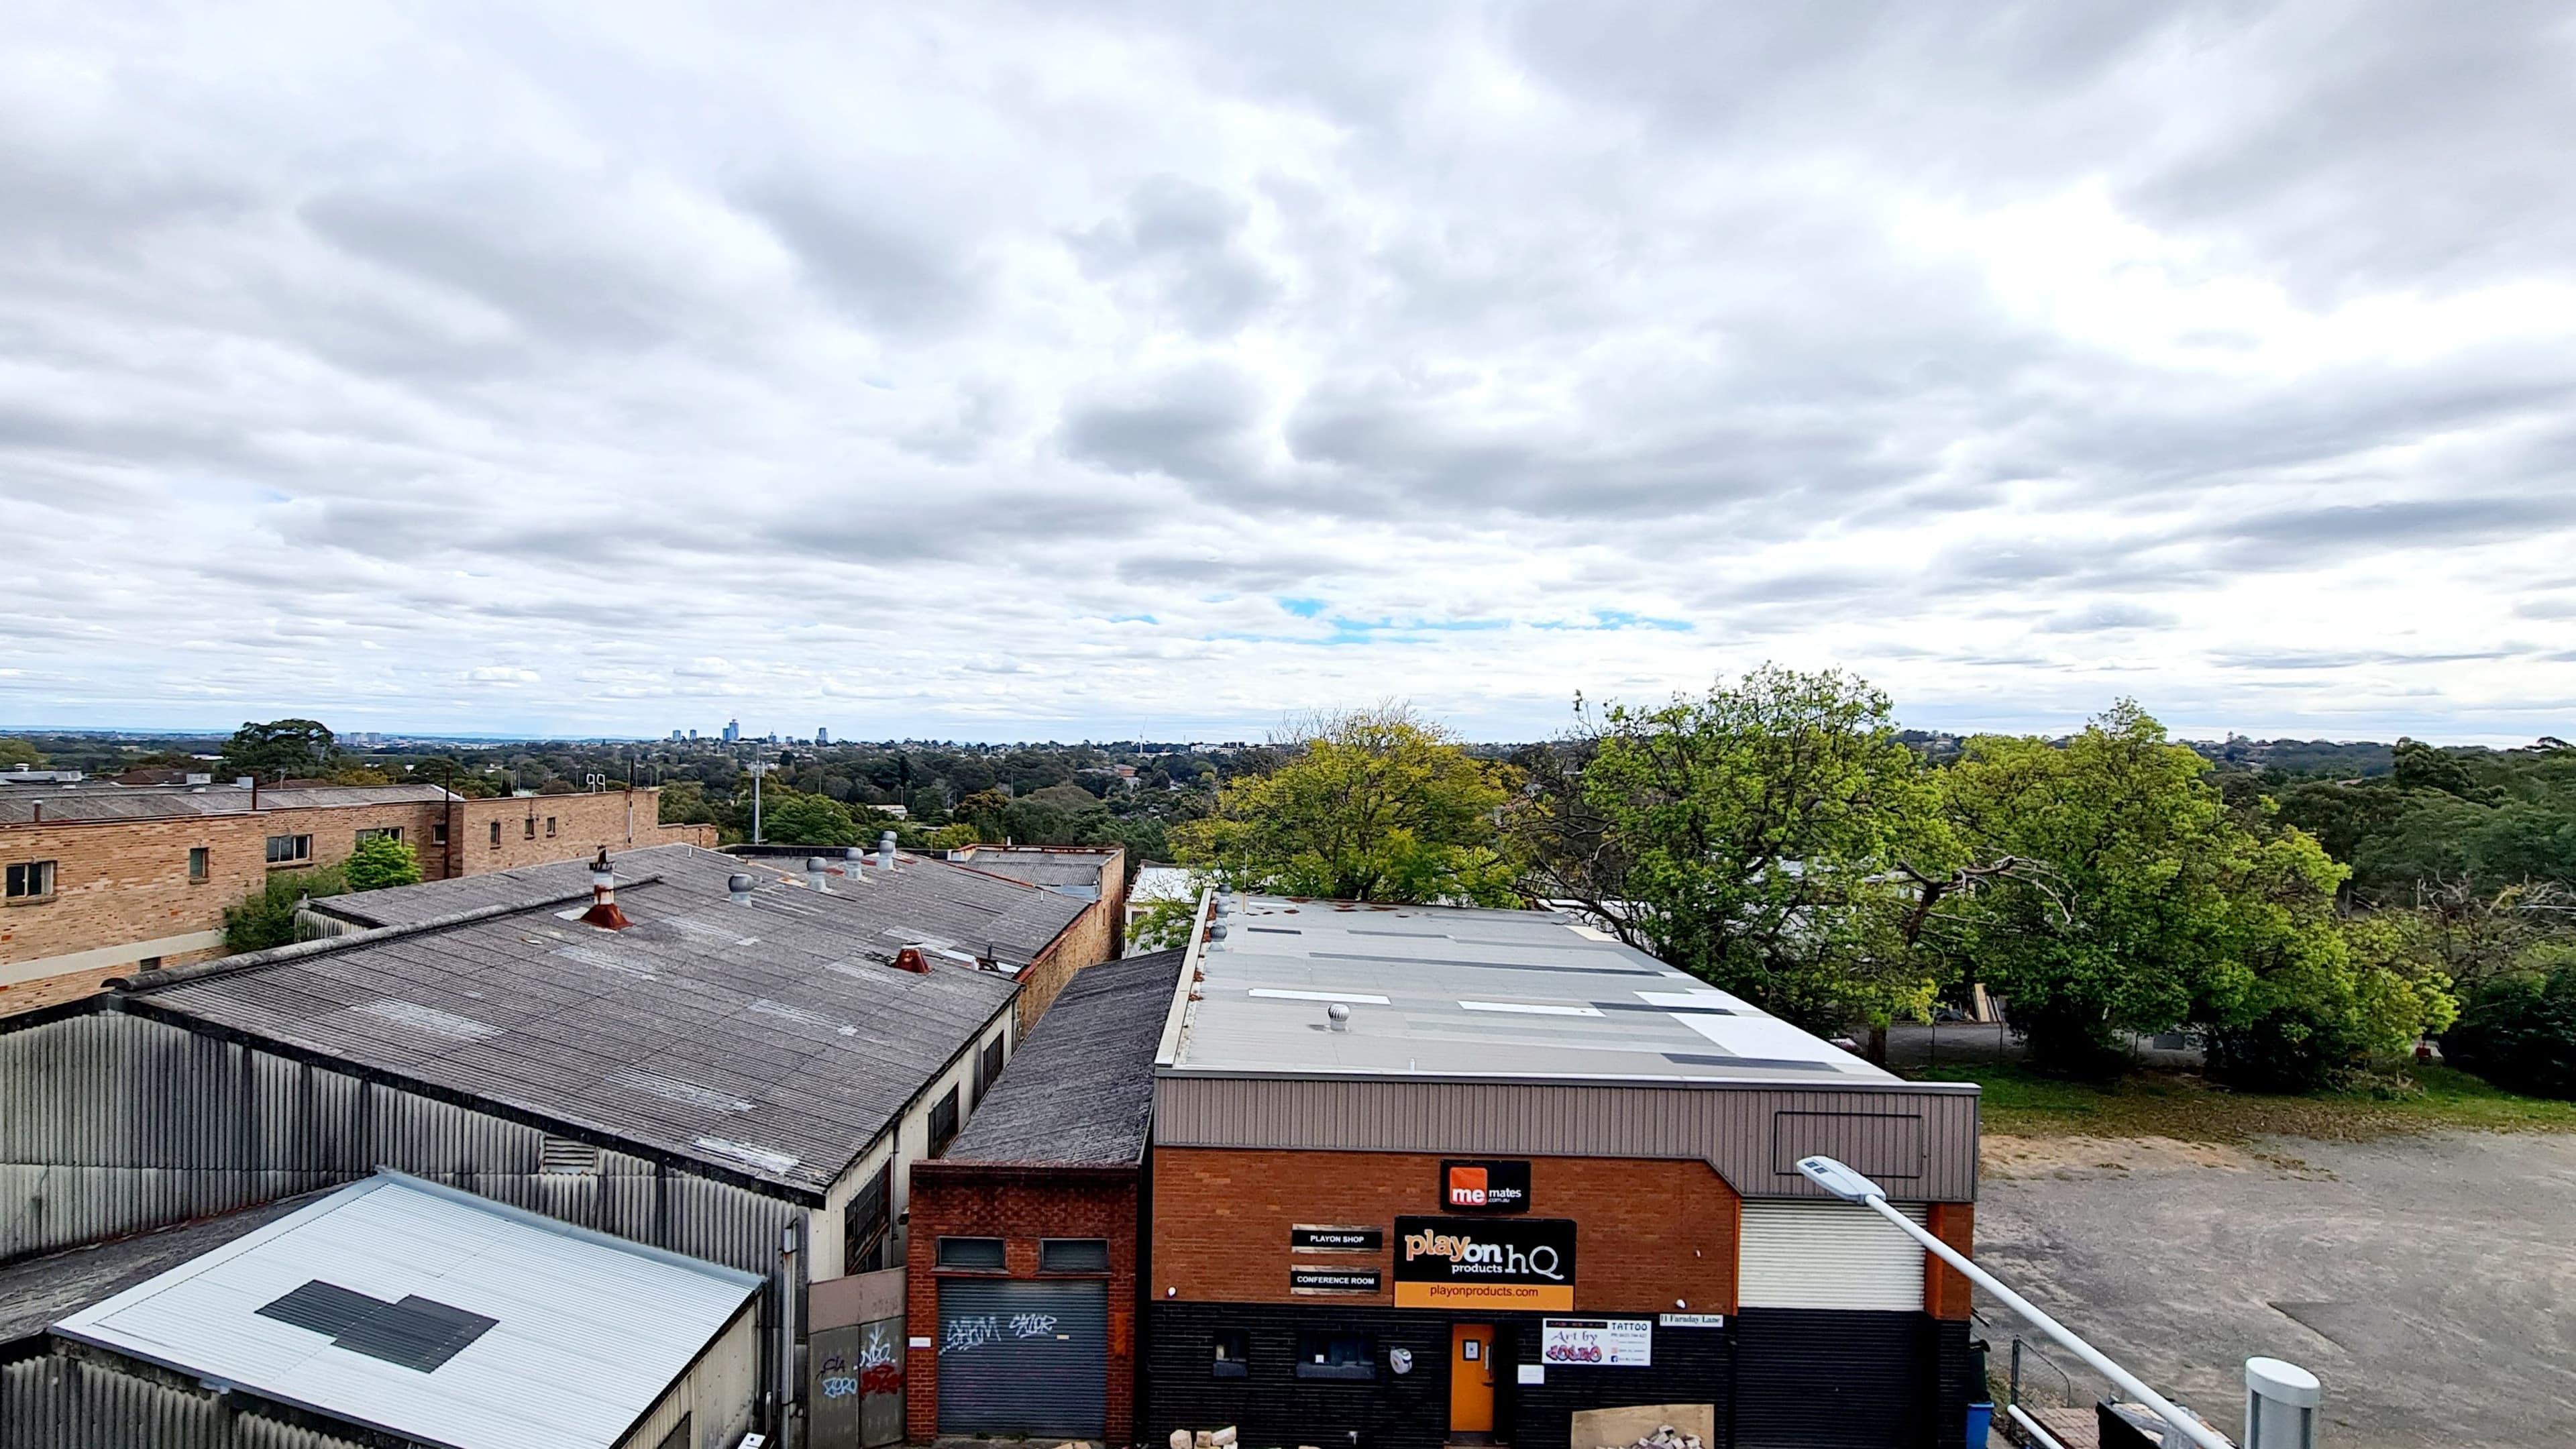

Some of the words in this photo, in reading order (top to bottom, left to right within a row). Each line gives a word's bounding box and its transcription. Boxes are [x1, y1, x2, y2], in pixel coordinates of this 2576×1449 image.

[1452, 1188, 1485, 1203] me
[1489, 1187, 1521, 1197] mates
[1405, 1229, 1503, 1262] playon
[1505, 1244, 1565, 1280] hQ
[1452, 1263, 1503, 1274] products
[1297, 1276, 1349, 1284] CONFERENCE
[1430, 1285, 1538, 1297] playonproducts.com
[1612, 1322, 1648, 1331] TATTOO
[1551, 1331, 1576, 1344] Art
[1582, 1331, 1598, 1345] by
